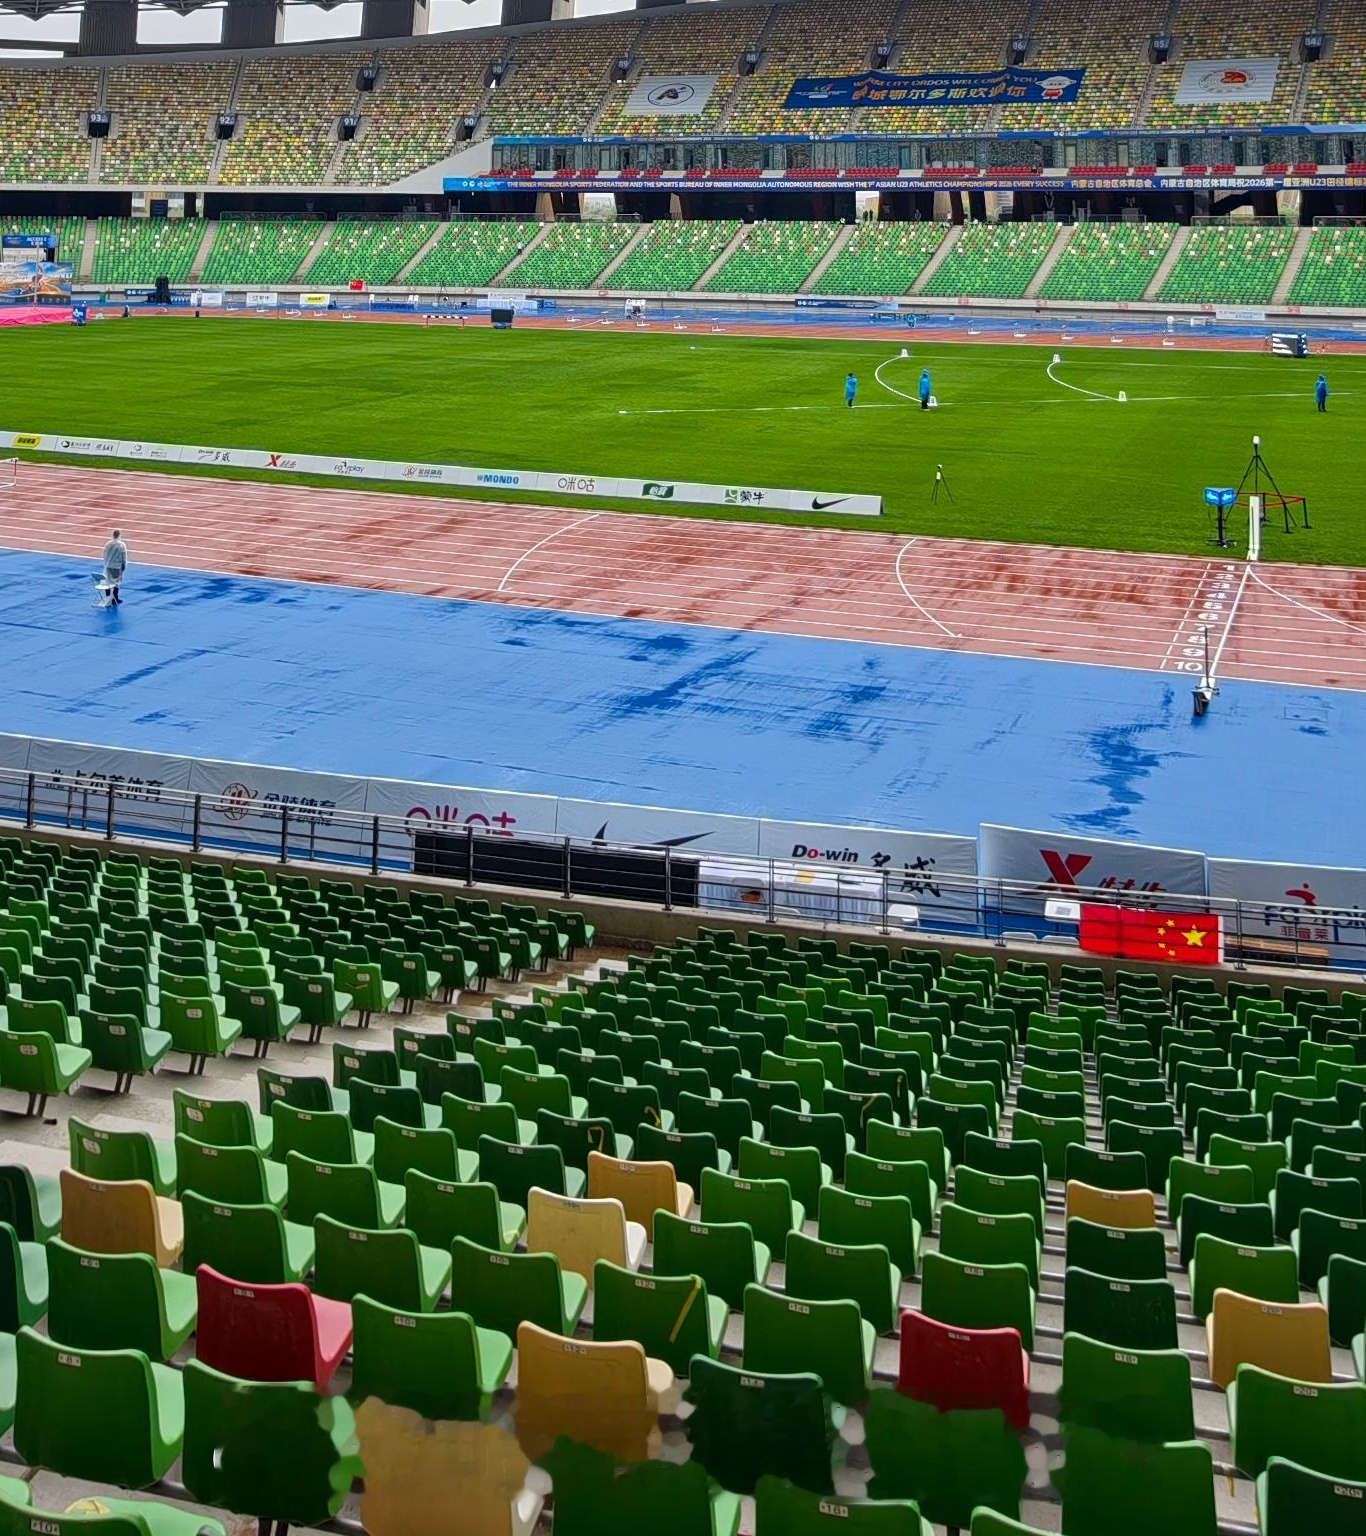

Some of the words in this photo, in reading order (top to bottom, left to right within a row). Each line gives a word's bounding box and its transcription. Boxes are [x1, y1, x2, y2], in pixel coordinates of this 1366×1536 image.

[911, 78, 950, 87] ORDOS
[508, 180, 518, 188] THE
[519, 180, 537, 188] INNER
[538, 180, 569, 188] MONGOLIA
[570, 180, 592, 188] SPORTS
[593, 180, 629, 188] FEDERATION
[630, 180, 643, 188] AND
[644, 180, 656, 188] THE
[656, 180, 678, 188] SPORTS
[679, 180, 704, 188] BUREAU
[705, 180, 713, 188] OF
[714, 180, 732, 188] INNER
[733, 180, 767, 188] MONGOLIA
[768, 180, 813, 188] AUTONOMOUS
[814, 180, 837, 188] REGION
[838, 180, 855, 188] WISH
[856, 180, 867, 188] THE
[876, 180, 896, 188] ASIAN
[897, 180, 908, 188] U23
[909, 180, 942, 188] ATHLETICS
[944, 180, 998, 188] CHAMPIONSHIPS
[1013, 180, 1034, 188] EVERY
[1035, 180, 1065, 188] SUCCESS
[483, 474, 520, 485] MONDO
[791, 844, 859, 863] Do-win
